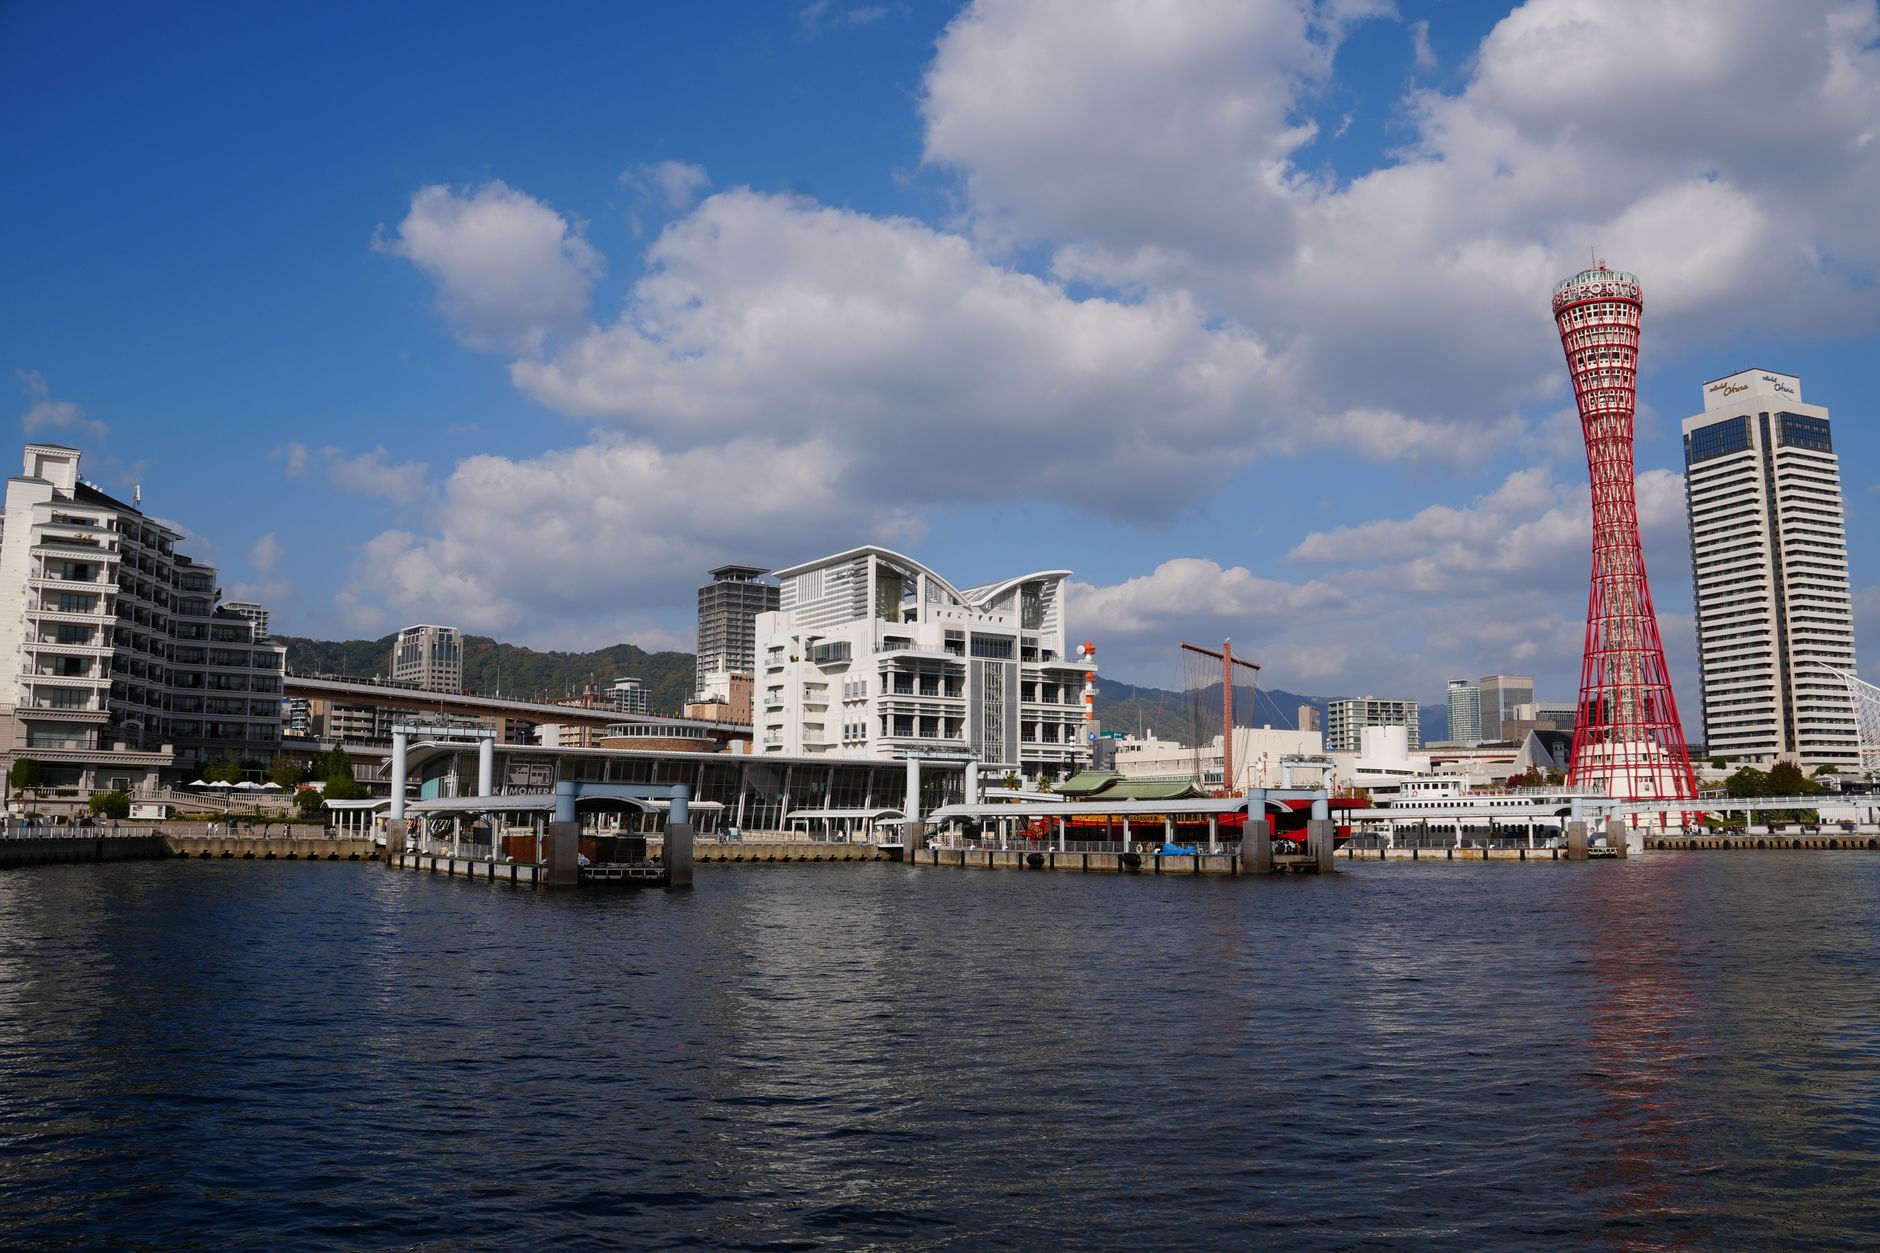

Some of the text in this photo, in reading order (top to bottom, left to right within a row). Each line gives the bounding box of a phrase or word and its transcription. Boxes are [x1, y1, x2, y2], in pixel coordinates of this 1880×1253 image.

[1578, 282, 1625, 296] PORT
[1724, 382, 1749, 396] Okura
[1774, 382, 1795, 394] Okura
